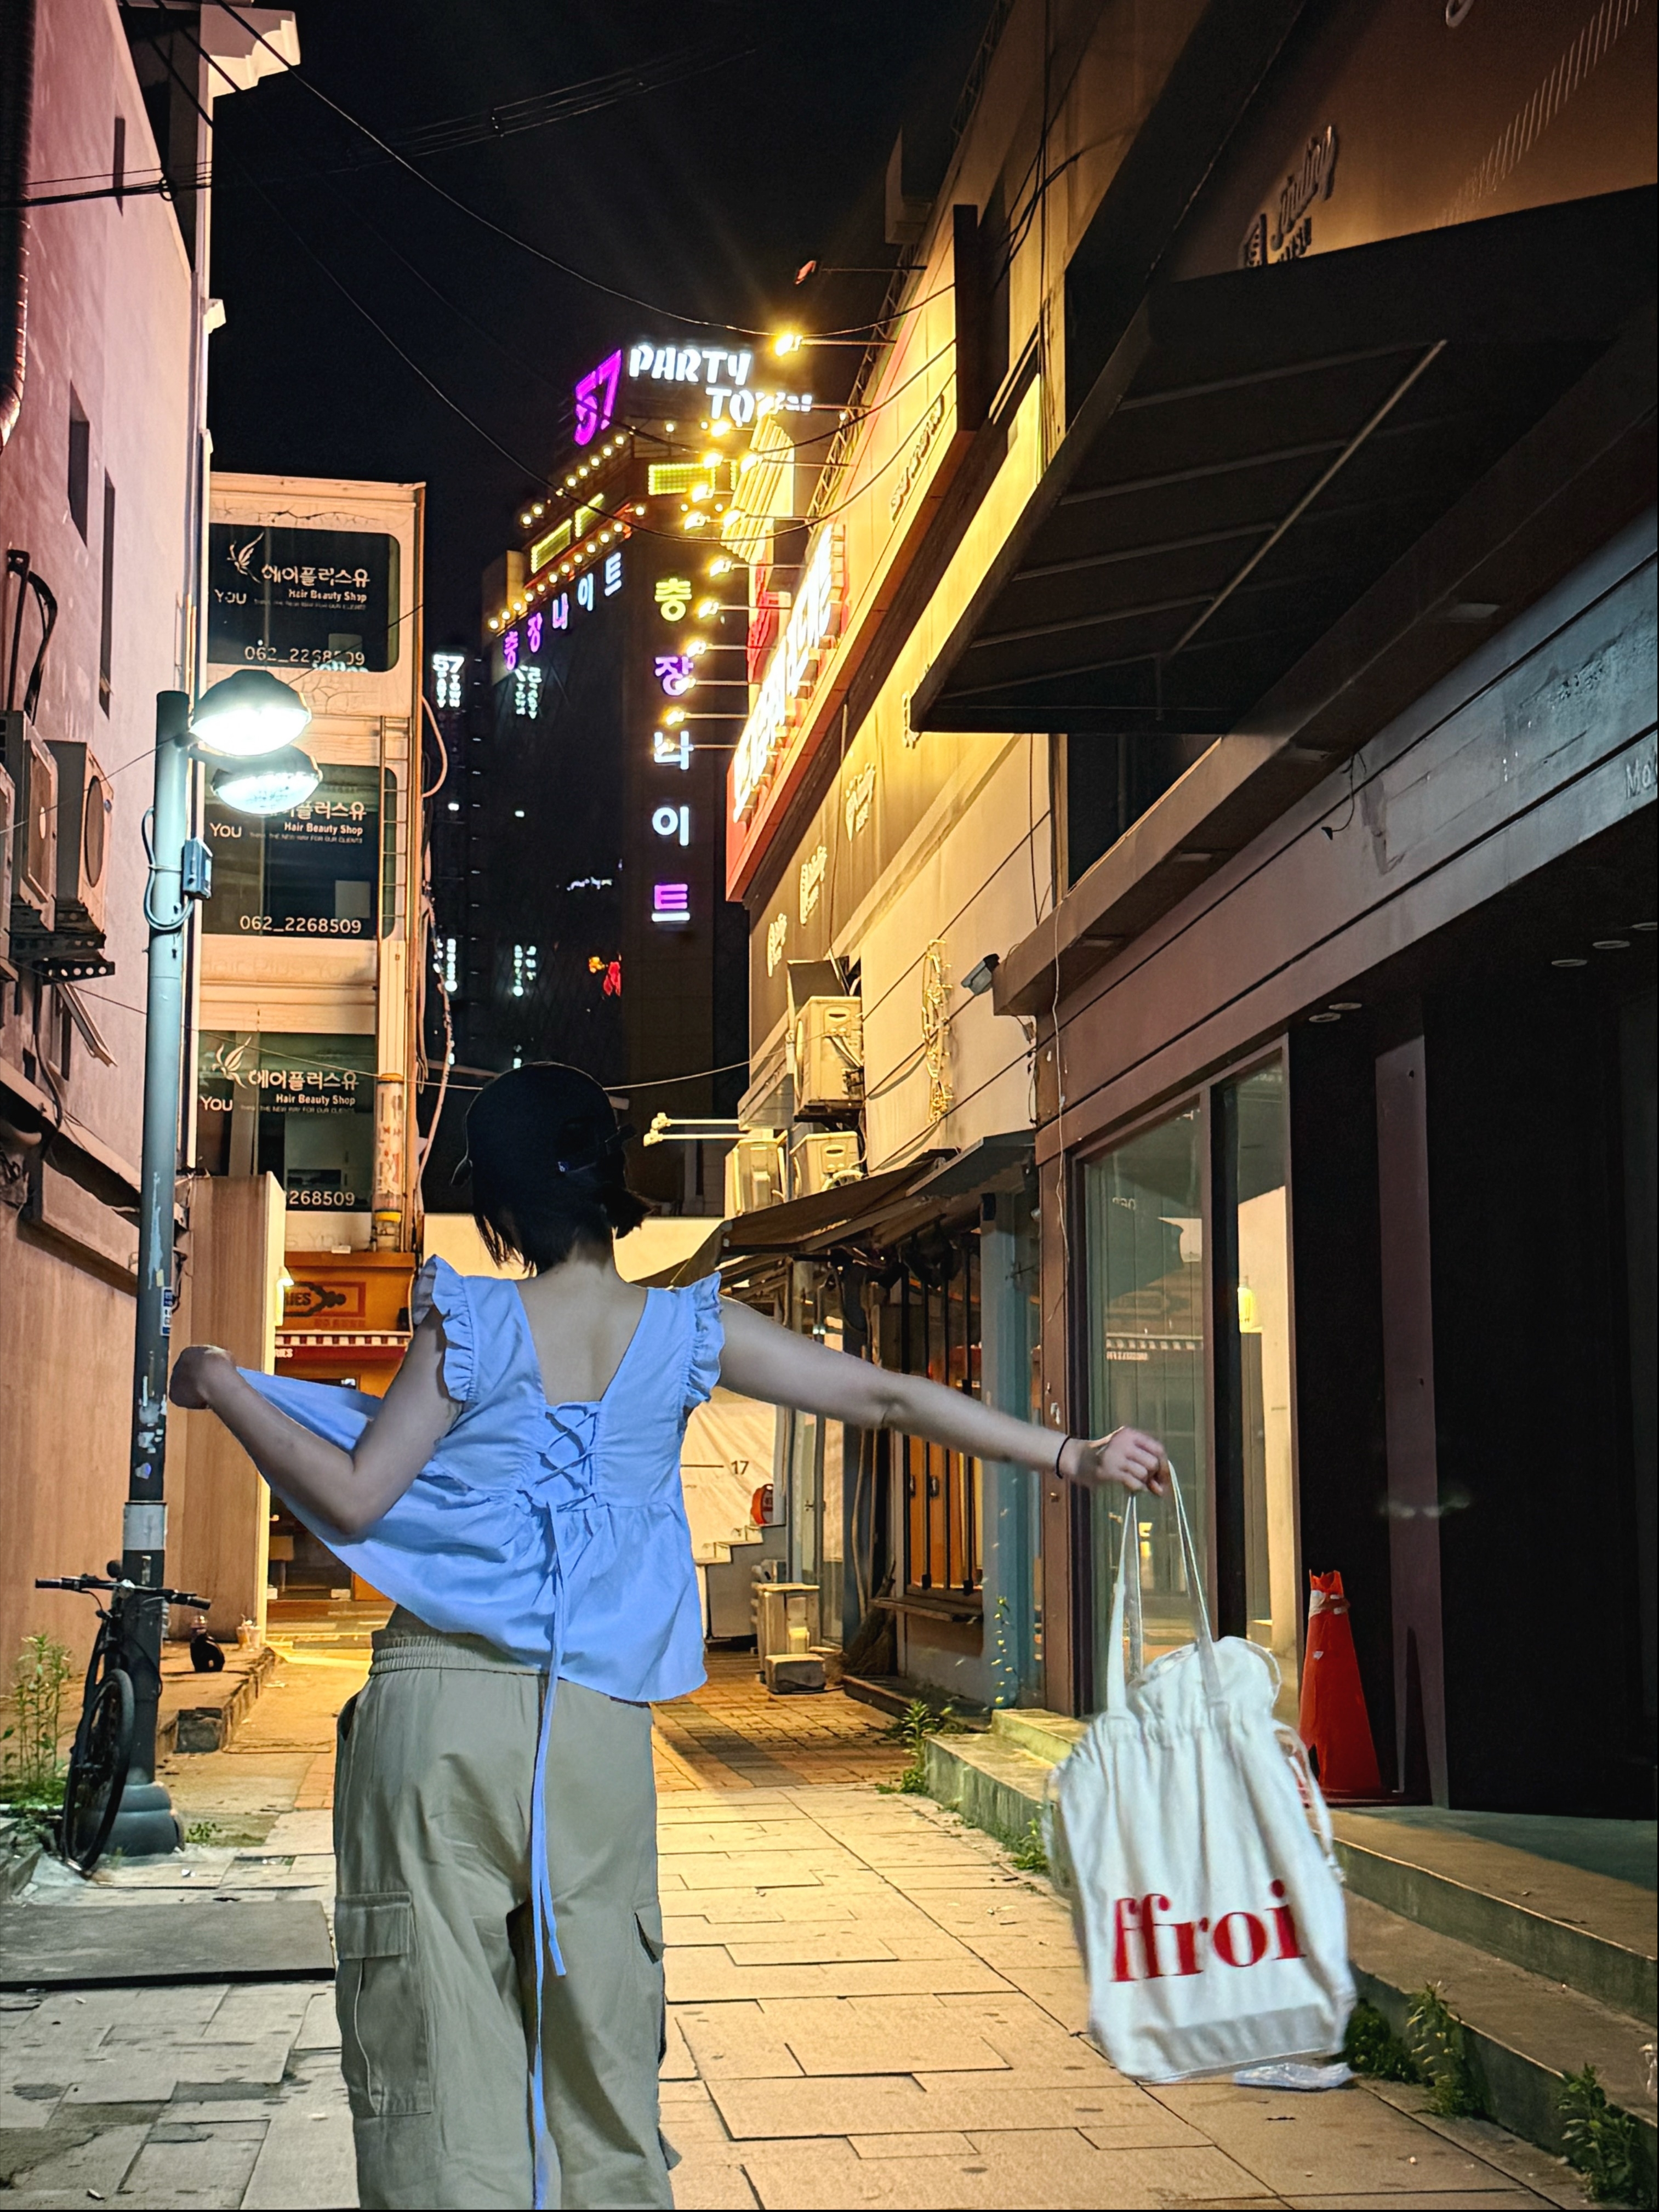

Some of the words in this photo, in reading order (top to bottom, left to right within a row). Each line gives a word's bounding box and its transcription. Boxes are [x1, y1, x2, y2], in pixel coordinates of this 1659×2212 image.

[629, 345, 751, 385] PARTY
[574, 349, 622, 445] 57
[288, 589, 308, 598] Hair
[310, 590, 341, 602] Beauty
[344, 592, 367, 603] Shop
[504, 552, 621, 670] 충장나이트
[433, 654, 464, 673] 57
[653, 578, 694, 922] 충장나이트
[210, 823, 242, 837] YOU
[284, 822, 303, 831] Hair
[306, 823, 338, 835] Beauty
[340, 825, 363, 836] Shop
[240, 916, 362, 933] 062_2268509
[248, 1070, 359, 1091] 에이플러스유
[201, 1097, 233, 1111] YOU
[276, 1094, 295, 1103] Hair
[298, 1094, 330, 1105] Beauty
[332, 1095, 356, 1105] Shop
[731, 1461, 749, 1475] 17
[1109, 1879, 1307, 1982] ffroi
